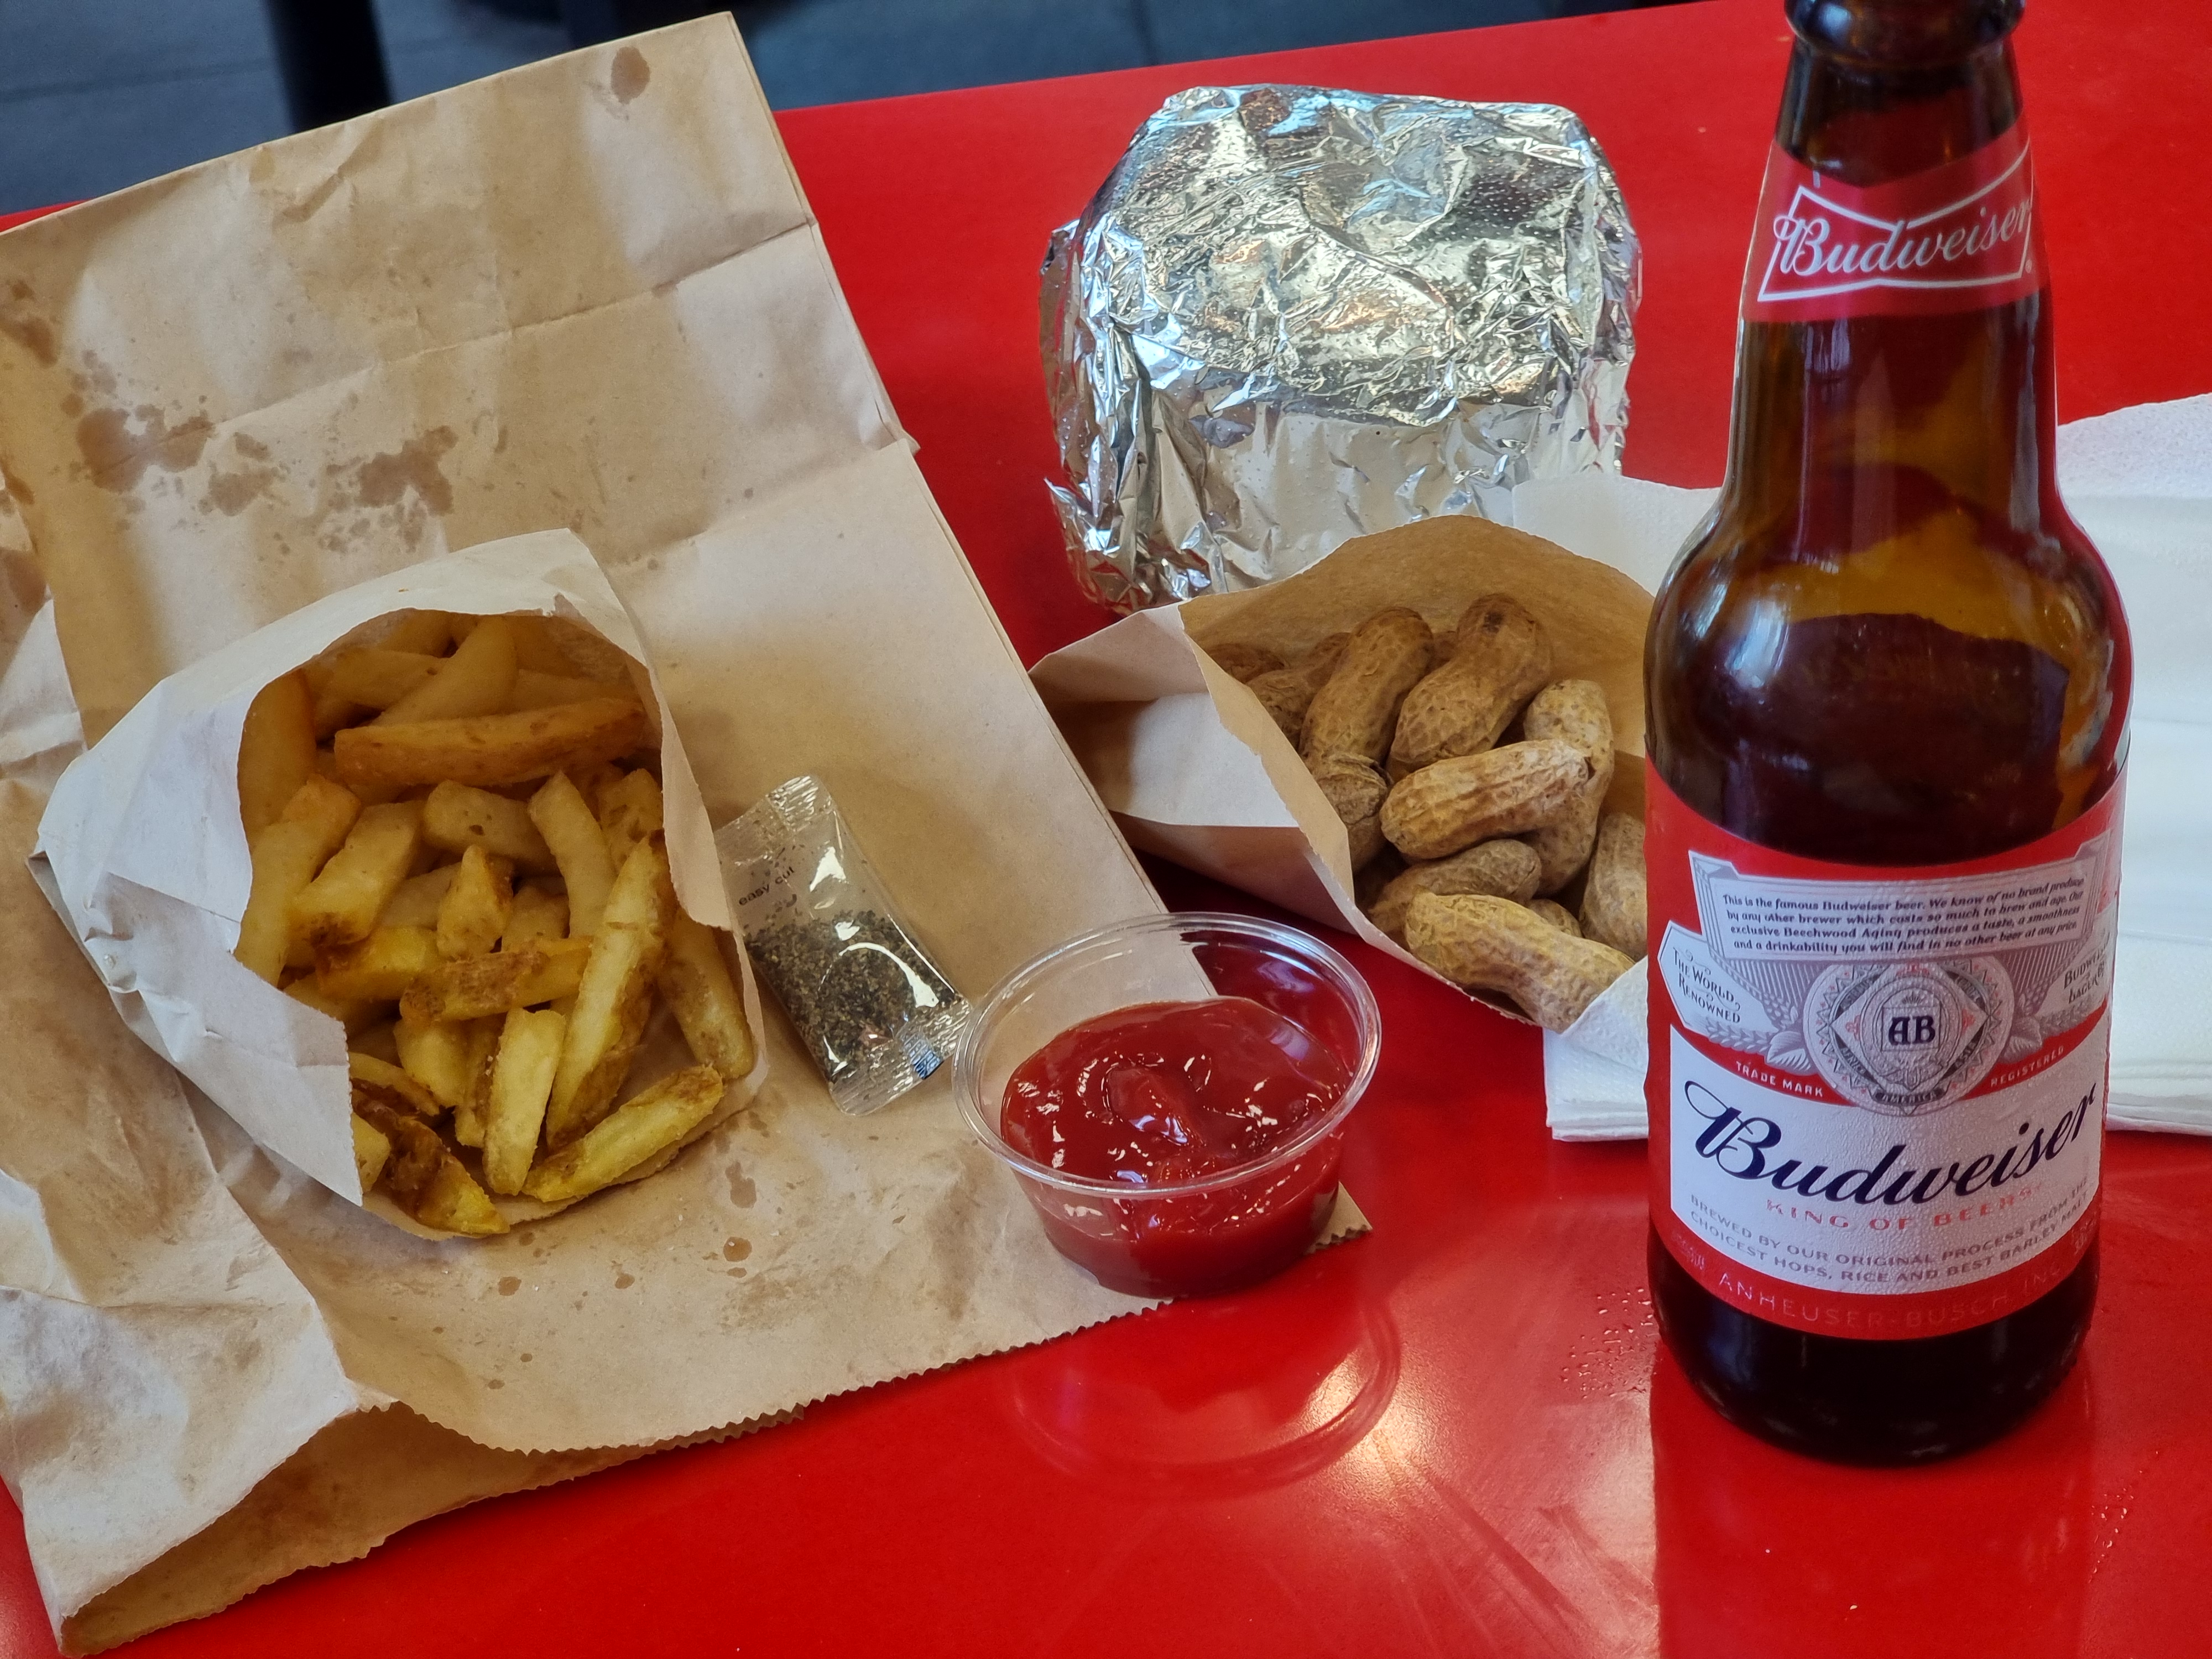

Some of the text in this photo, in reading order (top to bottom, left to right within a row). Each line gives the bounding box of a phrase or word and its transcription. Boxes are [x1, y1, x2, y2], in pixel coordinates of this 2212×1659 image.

[1773, 199, 2031, 276] Budweiser
[739, 866, 795, 906] easy cut
[1723, 894, 1743, 905] This
[1745, 896, 1753, 906] is
[1756, 897, 1772, 907] the
[1775, 898, 1818, 910] famous
[1823, 901, 1891, 911] Budweiser
[1895, 900, 1926, 910] beer.
[1929, 898, 1947, 909] We
[1951, 895, 1984, 906] know
[1986, 891, 2001, 904] of
[2002, 891, 2016, 900] no
[2018, 883, 2049, 898] brand
[1727, 910, 1739, 922] by
[1742, 914, 1761, 923] any
[1765, 913, 1794, 922] other
[1799, 914, 1841, 924] brewer
[1847, 914, 1884, 924] which
[1890, 914, 1923, 924] costs
[1927, 914, 1942, 922] so
[1946, 909, 1979, 920] much
[1984, 907, 1996, 917] to
[1999, 904, 2026, 914] brew
[2029, 896, 2049, 910] and
[2069, 890, 2084, 901] Our
[1731, 925, 1780, 936] exclusive
[1784, 927, 1856, 938] Beechwood
[1862, 927, 1901, 940] Aging
[1907, 926, 1968, 938] produces
[1984, 919, 2015, 930] taste,
[2026, 906, 2080, 924] smoothness
[1734, 940, 1752, 949] and
[1766, 941, 1837, 954] drinkability
[1841, 944, 1865, 954] you
[1870, 942, 1893, 952] will
[1897, 940, 1924, 953] find
[1928, 939, 1940, 950] in
[1965, 935, 1997, 945] other
[2000, 931, 2022, 942] beer
[2025, 927, 2036, 938] at
[2038, 926, 2056, 935] any
[1673, 947, 1738, 1005] THE WORLD
[1679, 972, 1740, 1023] RENOWNED
[1888, 1015, 1936, 1046] AB
[1736, 1061, 1823, 1097] TRADE MARK
[1991, 1045, 2064, 1087] REGISTERED
[1882, 1091, 1936, 1104] AMERICA
[1684, 1080, 2096, 1205] Budweiser
[1767, 1188, 2032, 1230] KING OF BEERS
[1691, 1194, 1752, 1238] BREWED
[1759, 1235, 1781, 1249] BY
[1787, 1245, 1828, 1261] OUR
[1835, 1253, 1933, 1266] ORIGINAL
[1942, 1227, 2024, 1261] PROCESS
[2030, 1198, 2068, 1231] FROM
[1691, 1211, 1767, 1261] CHOICEST
[1775, 1256, 1832, 1280] HOPS,
[1841, 1271, 1889, 1282] RICE
[1896, 1270, 1938, 1282] AND
[1947, 1256, 1993, 1276] BEST
[2000, 1219, 2058, 1261] BARLEY
[2062, 1190, 2088, 1225] MALT
